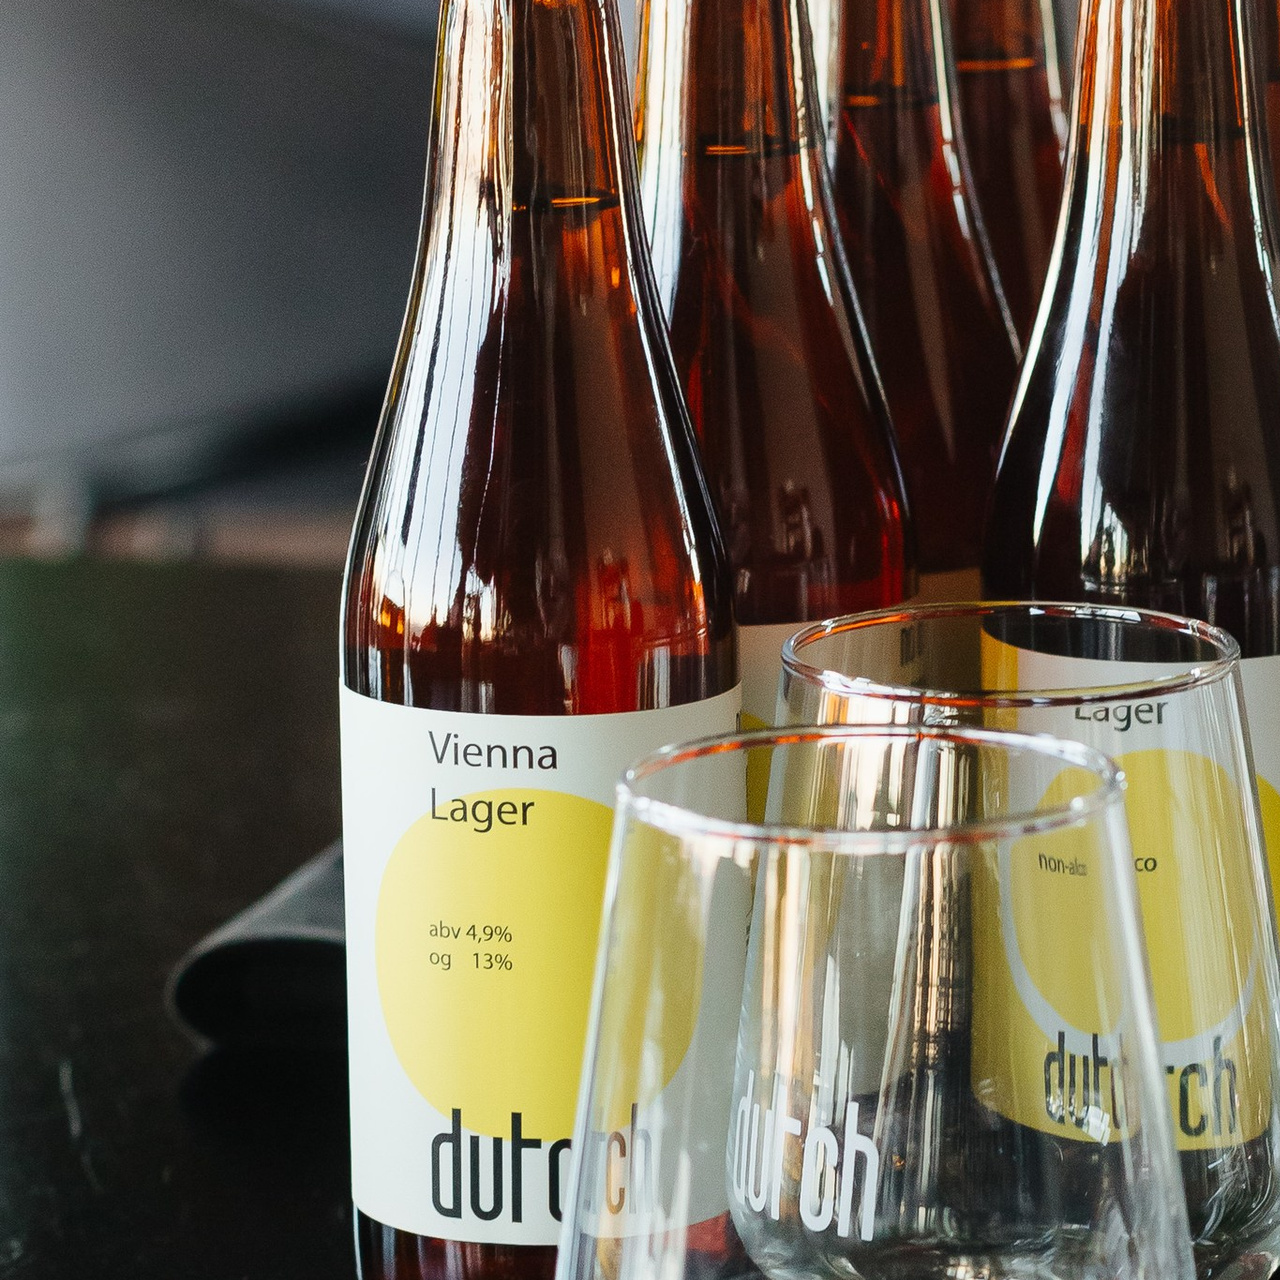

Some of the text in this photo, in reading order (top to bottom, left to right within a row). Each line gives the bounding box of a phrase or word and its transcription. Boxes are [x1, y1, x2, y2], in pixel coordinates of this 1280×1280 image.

[428, 730, 558, 770] Vienna
[431, 787, 535, 834] Lager
[429, 920, 513, 944] abv 4,9%
[429, 952, 513, 971] og 13%
[733, 1069, 880, 1242] dutch
